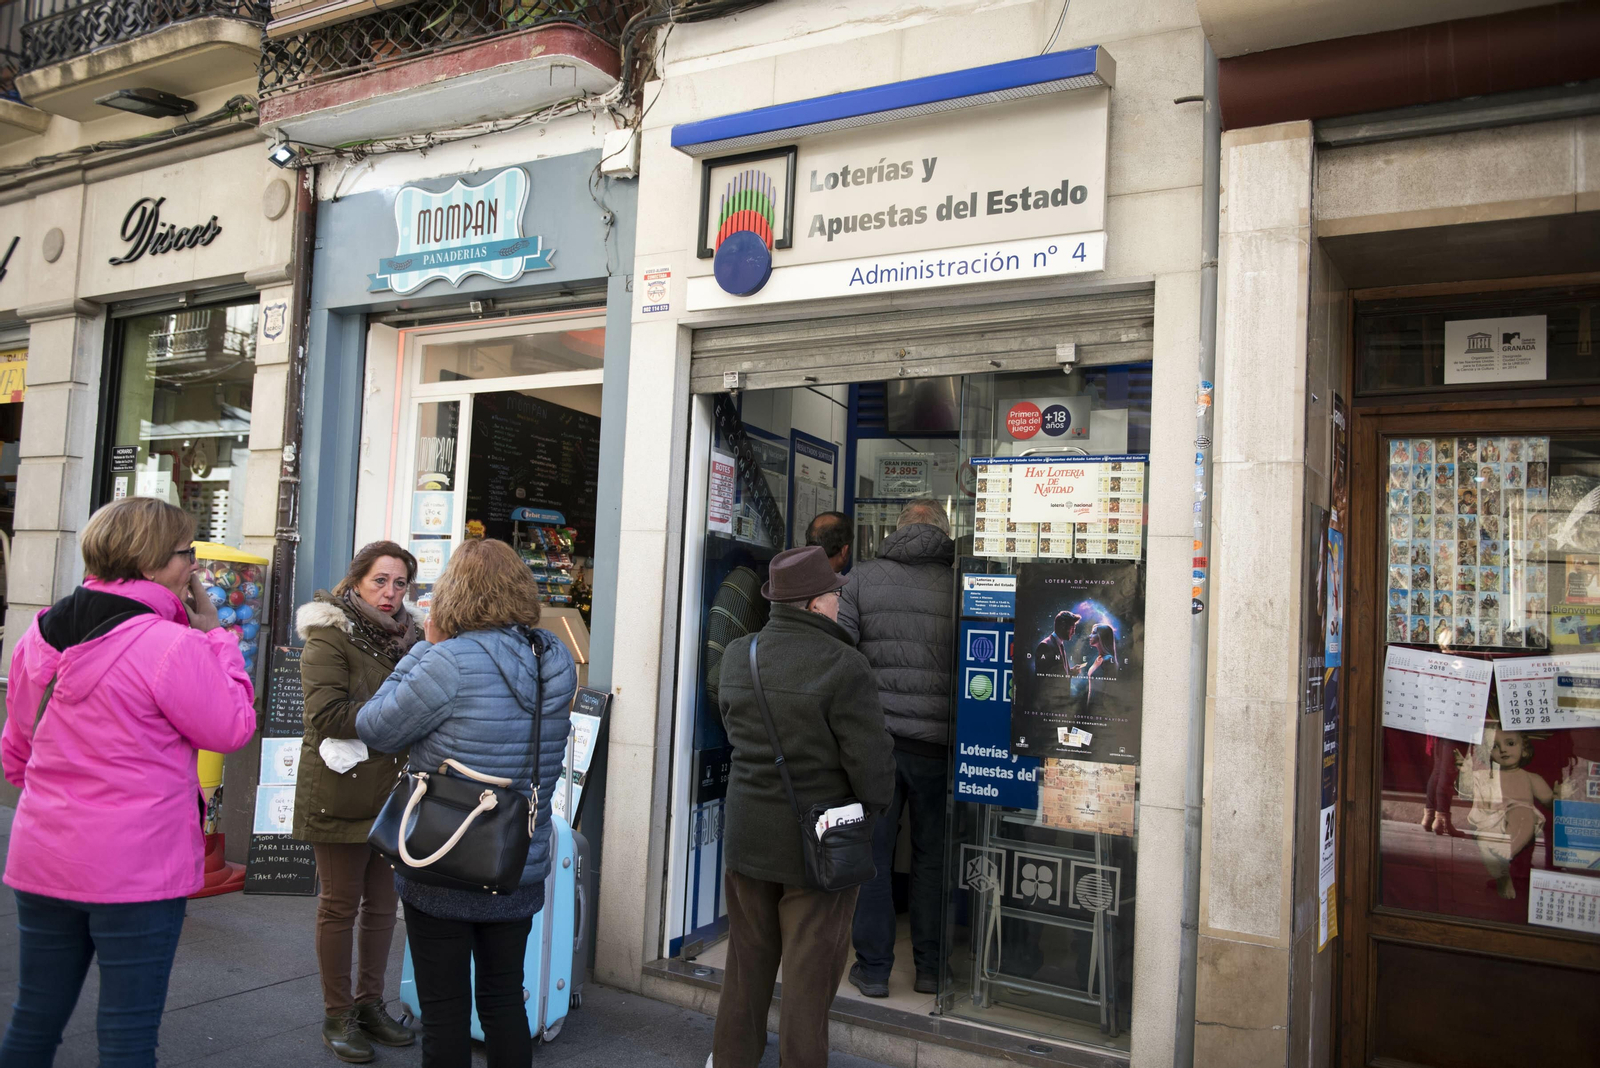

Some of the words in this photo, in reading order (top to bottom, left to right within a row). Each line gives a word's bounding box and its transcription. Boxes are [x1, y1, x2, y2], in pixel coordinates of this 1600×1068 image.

[810, 157, 914, 193] Loterías
[921, 157, 938, 184] y
[808, 203, 928, 243] Apuestas
[936, 192, 977, 224] del
[986, 179, 1088, 216] Estado
[108, 196, 222, 266] Discos
[417, 198, 498, 246] MOMPAN
[422, 246, 488, 266] PANADERIAS
[848, 250, 1020, 288] Administración
[1072, 242, 1088, 263] 4
[1045, 411, 1066, 422] +18
[715, 463, 731, 474] BOTES
[884, 467, 918, 475] 24.895
[1025, 467, 1045, 478] HAY
[1047, 466, 1085, 479] LOTERIA
[1034, 484, 1074, 497] NAVIDAD
[960, 742, 1008, 759] Loterías
[1011, 754, 1018, 763] y
[288, 768, 294, 776] 2
[959, 762, 1014, 779] Apuestas
[1017, 768, 1036, 782] del
[958, 781, 999, 797] Estado
[1324, 810, 1334, 842] 20
[1565, 826, 1600, 837] EXPRES
[1554, 855, 1590, 864] Welcome
